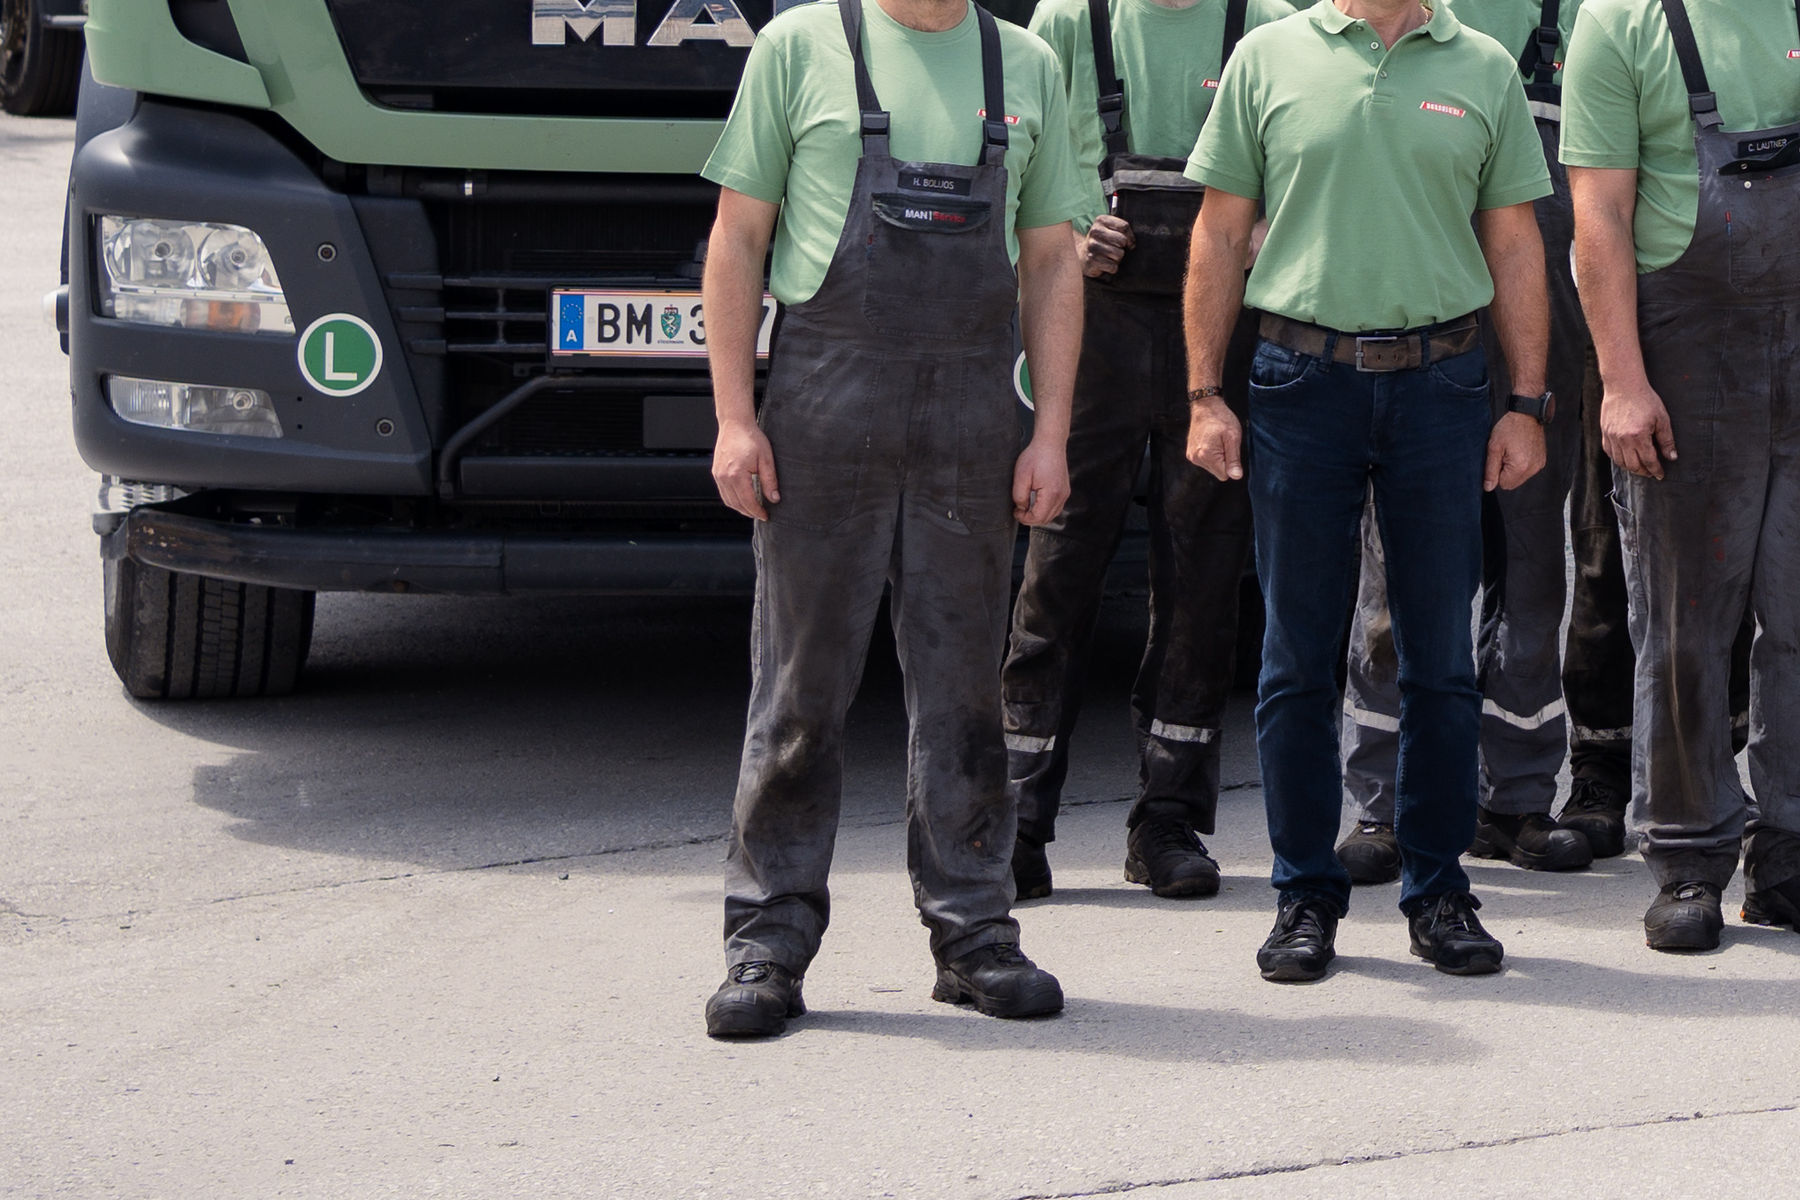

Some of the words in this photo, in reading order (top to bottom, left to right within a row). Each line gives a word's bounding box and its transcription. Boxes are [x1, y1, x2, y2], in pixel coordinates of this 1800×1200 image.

[905, 209, 928, 220] MAN
[566, 329, 577, 343] A
[598, 303, 653, 345] BM
[325, 331, 358, 381] L
